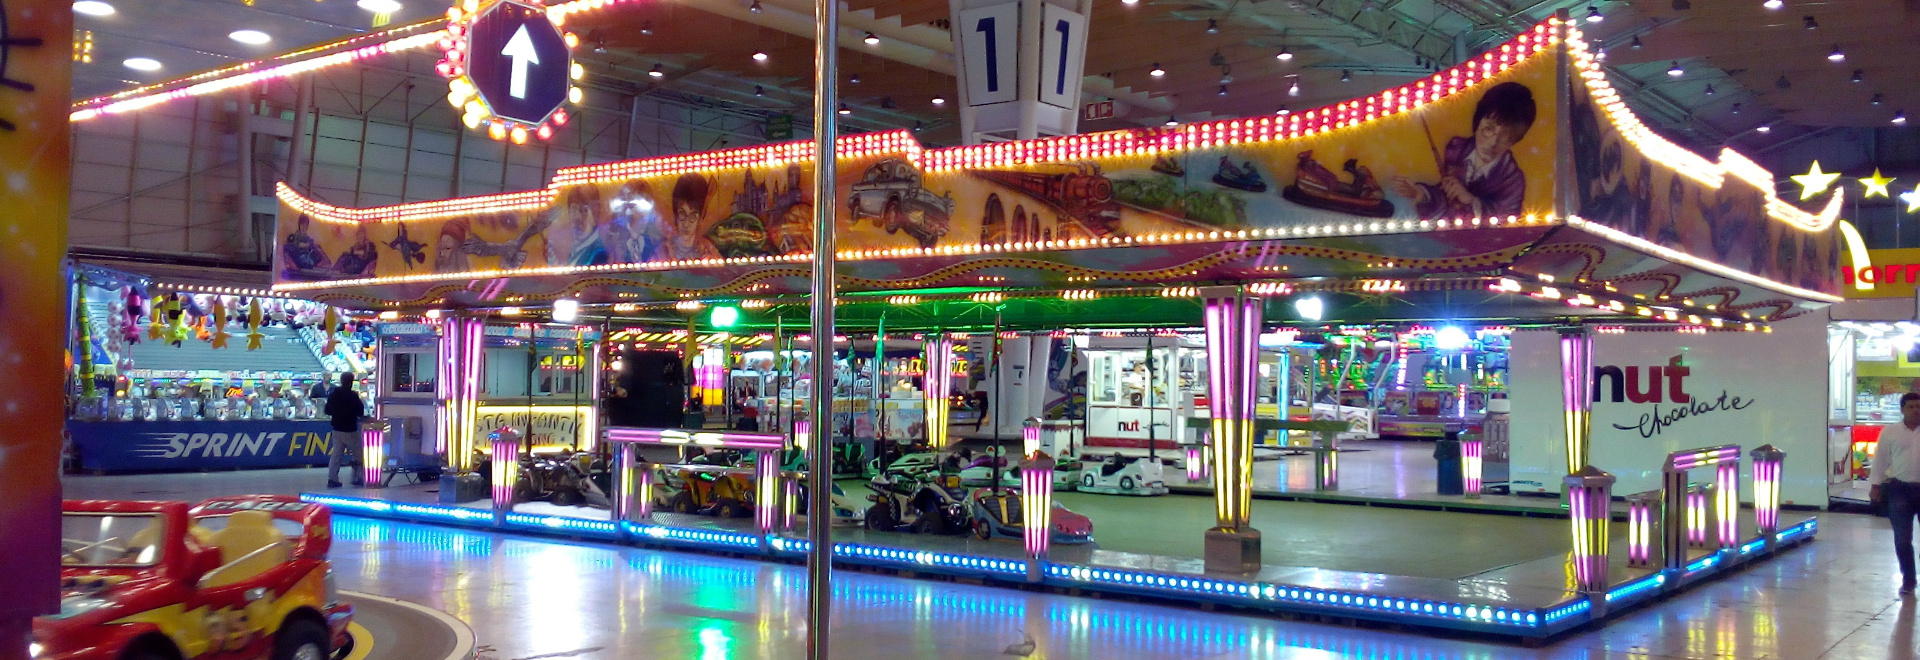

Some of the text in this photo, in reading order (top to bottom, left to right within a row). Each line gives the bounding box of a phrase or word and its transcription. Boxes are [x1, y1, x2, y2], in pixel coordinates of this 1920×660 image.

[976, 17, 998, 92] 1
[1055, 19, 1070, 95] 1
[1592, 354, 1690, 404] nut
[165, 432, 347, 458] SPRINT FIN
[1118, 419, 1140, 431] nut
